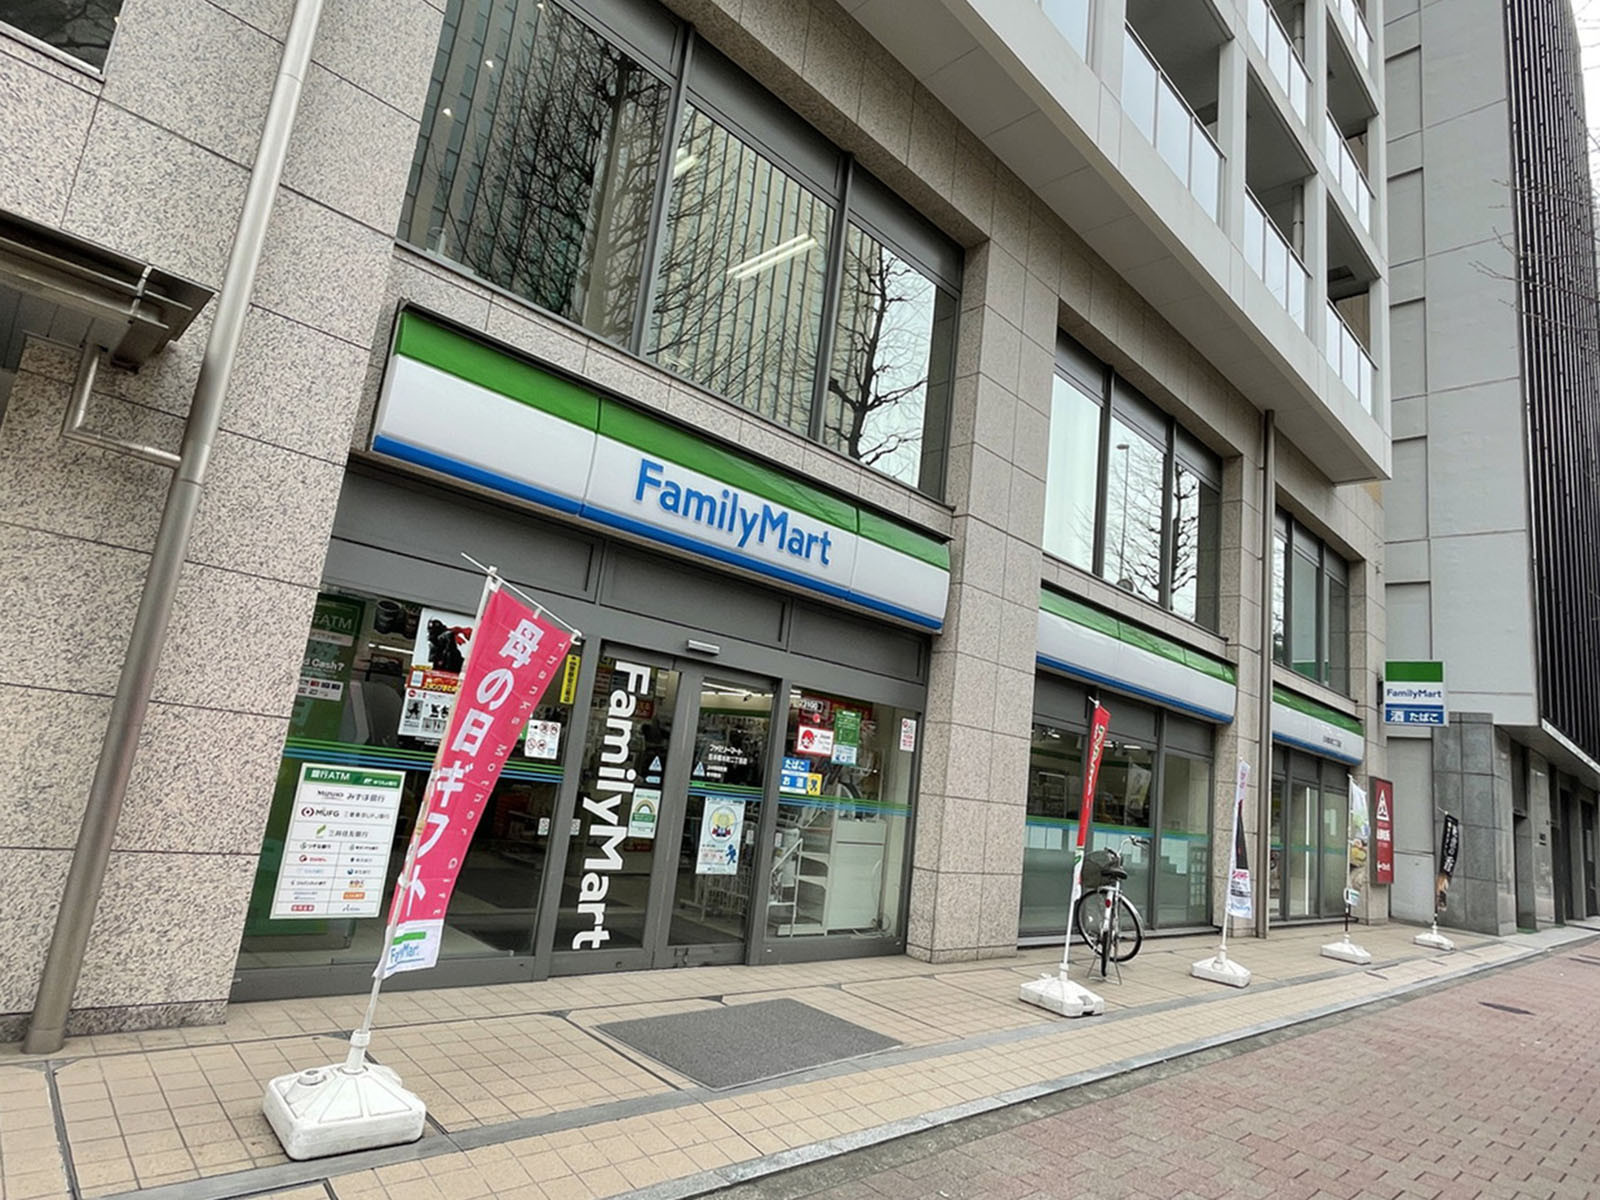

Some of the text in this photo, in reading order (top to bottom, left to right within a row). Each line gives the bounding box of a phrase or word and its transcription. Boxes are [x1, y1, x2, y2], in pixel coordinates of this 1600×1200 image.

[634, 458, 832, 566] FamilyMart
[1386, 688, 1442, 700] FamilyMart
[1391, 710, 1440, 724] 酒 たばこ
[405, 618, 544, 918] 母の日ギフト
[784, 758, 806, 771] たばこ
[311, 769, 350, 781] 銀行ATM
[572, 660, 651, 950] FamilyMart
